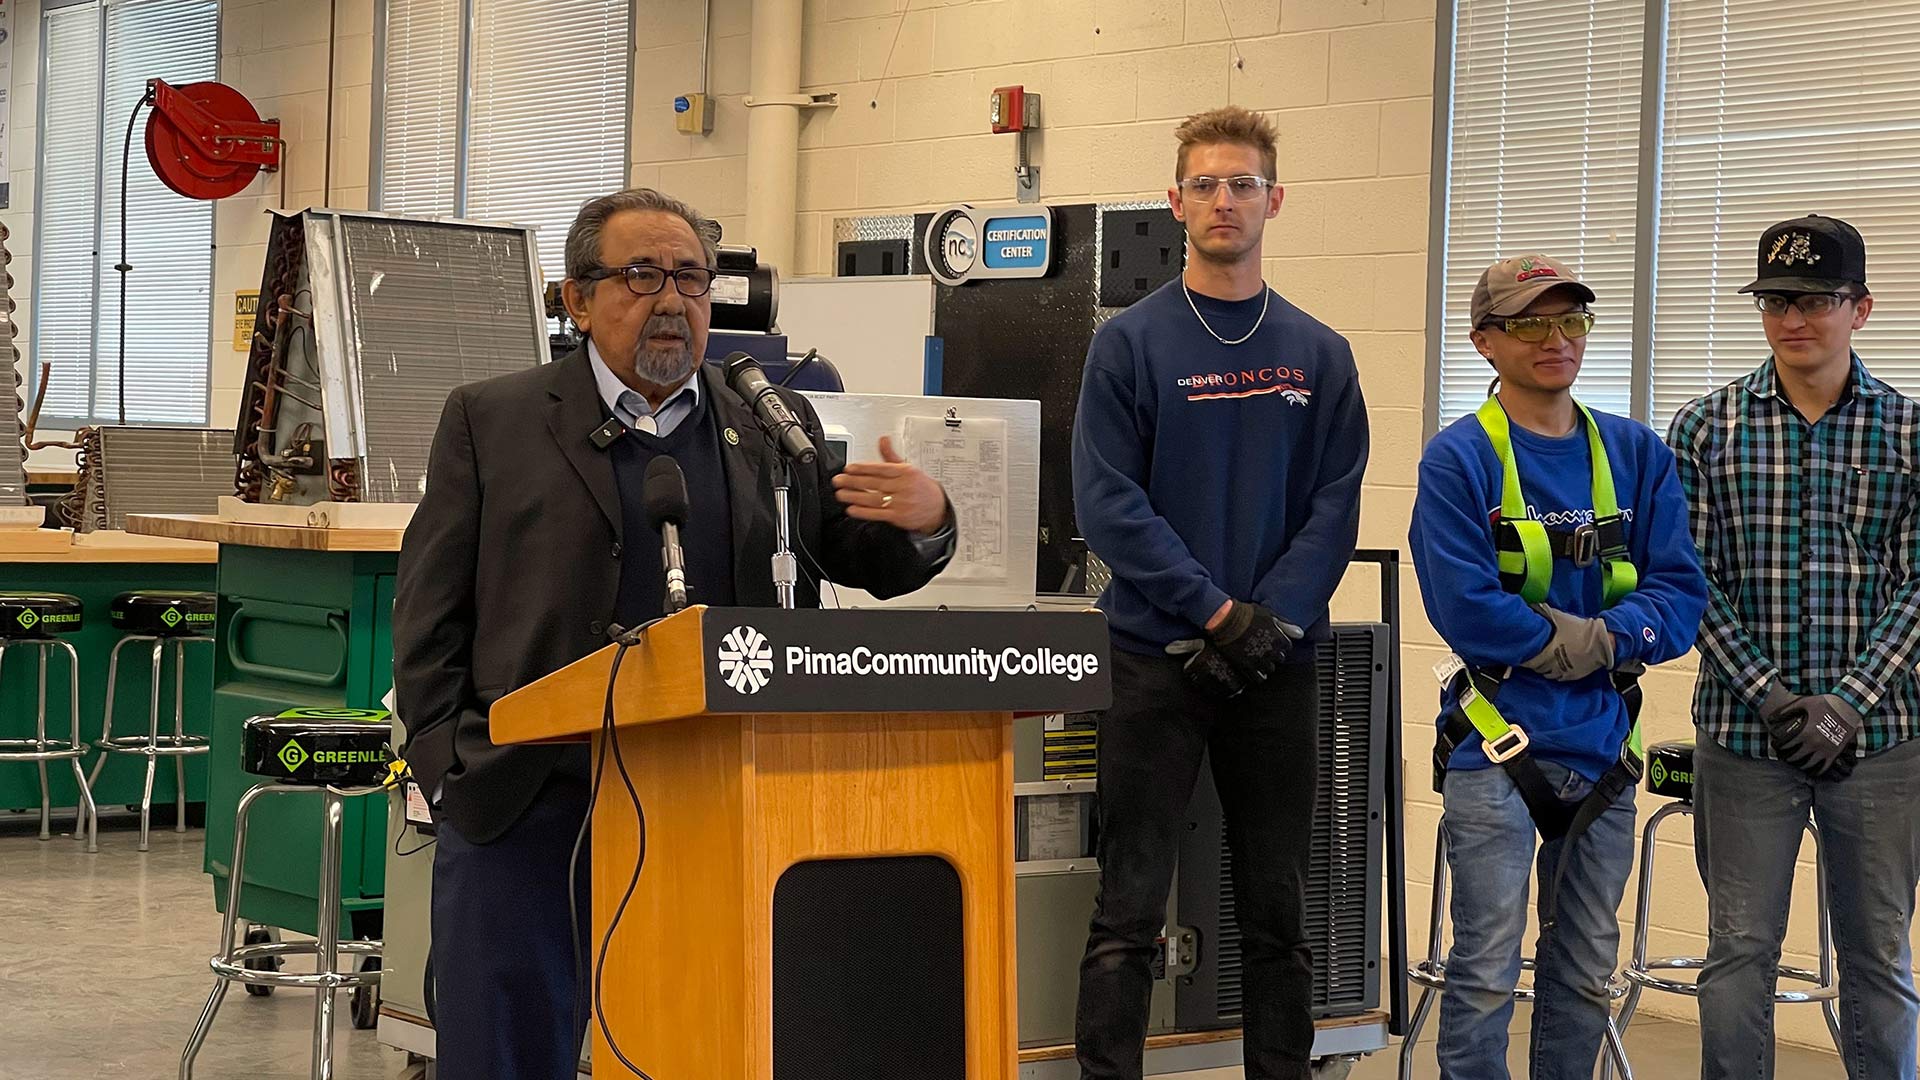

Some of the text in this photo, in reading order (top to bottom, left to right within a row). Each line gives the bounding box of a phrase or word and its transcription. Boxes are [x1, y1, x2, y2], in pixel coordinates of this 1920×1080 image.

[987, 228, 1047, 242] CERTIFICATION
[1000, 246, 1033, 258] CENTER
[237, 297, 259, 313] CAUT
[1177, 366, 1305, 388] DENVER BRONCOS
[41, 613, 81, 623] GREENLEE
[184, 613, 216, 622] GREEN
[786, 646, 1099, 681] PimaCommunityCollege
[313, 750, 386, 763] GREENLE
